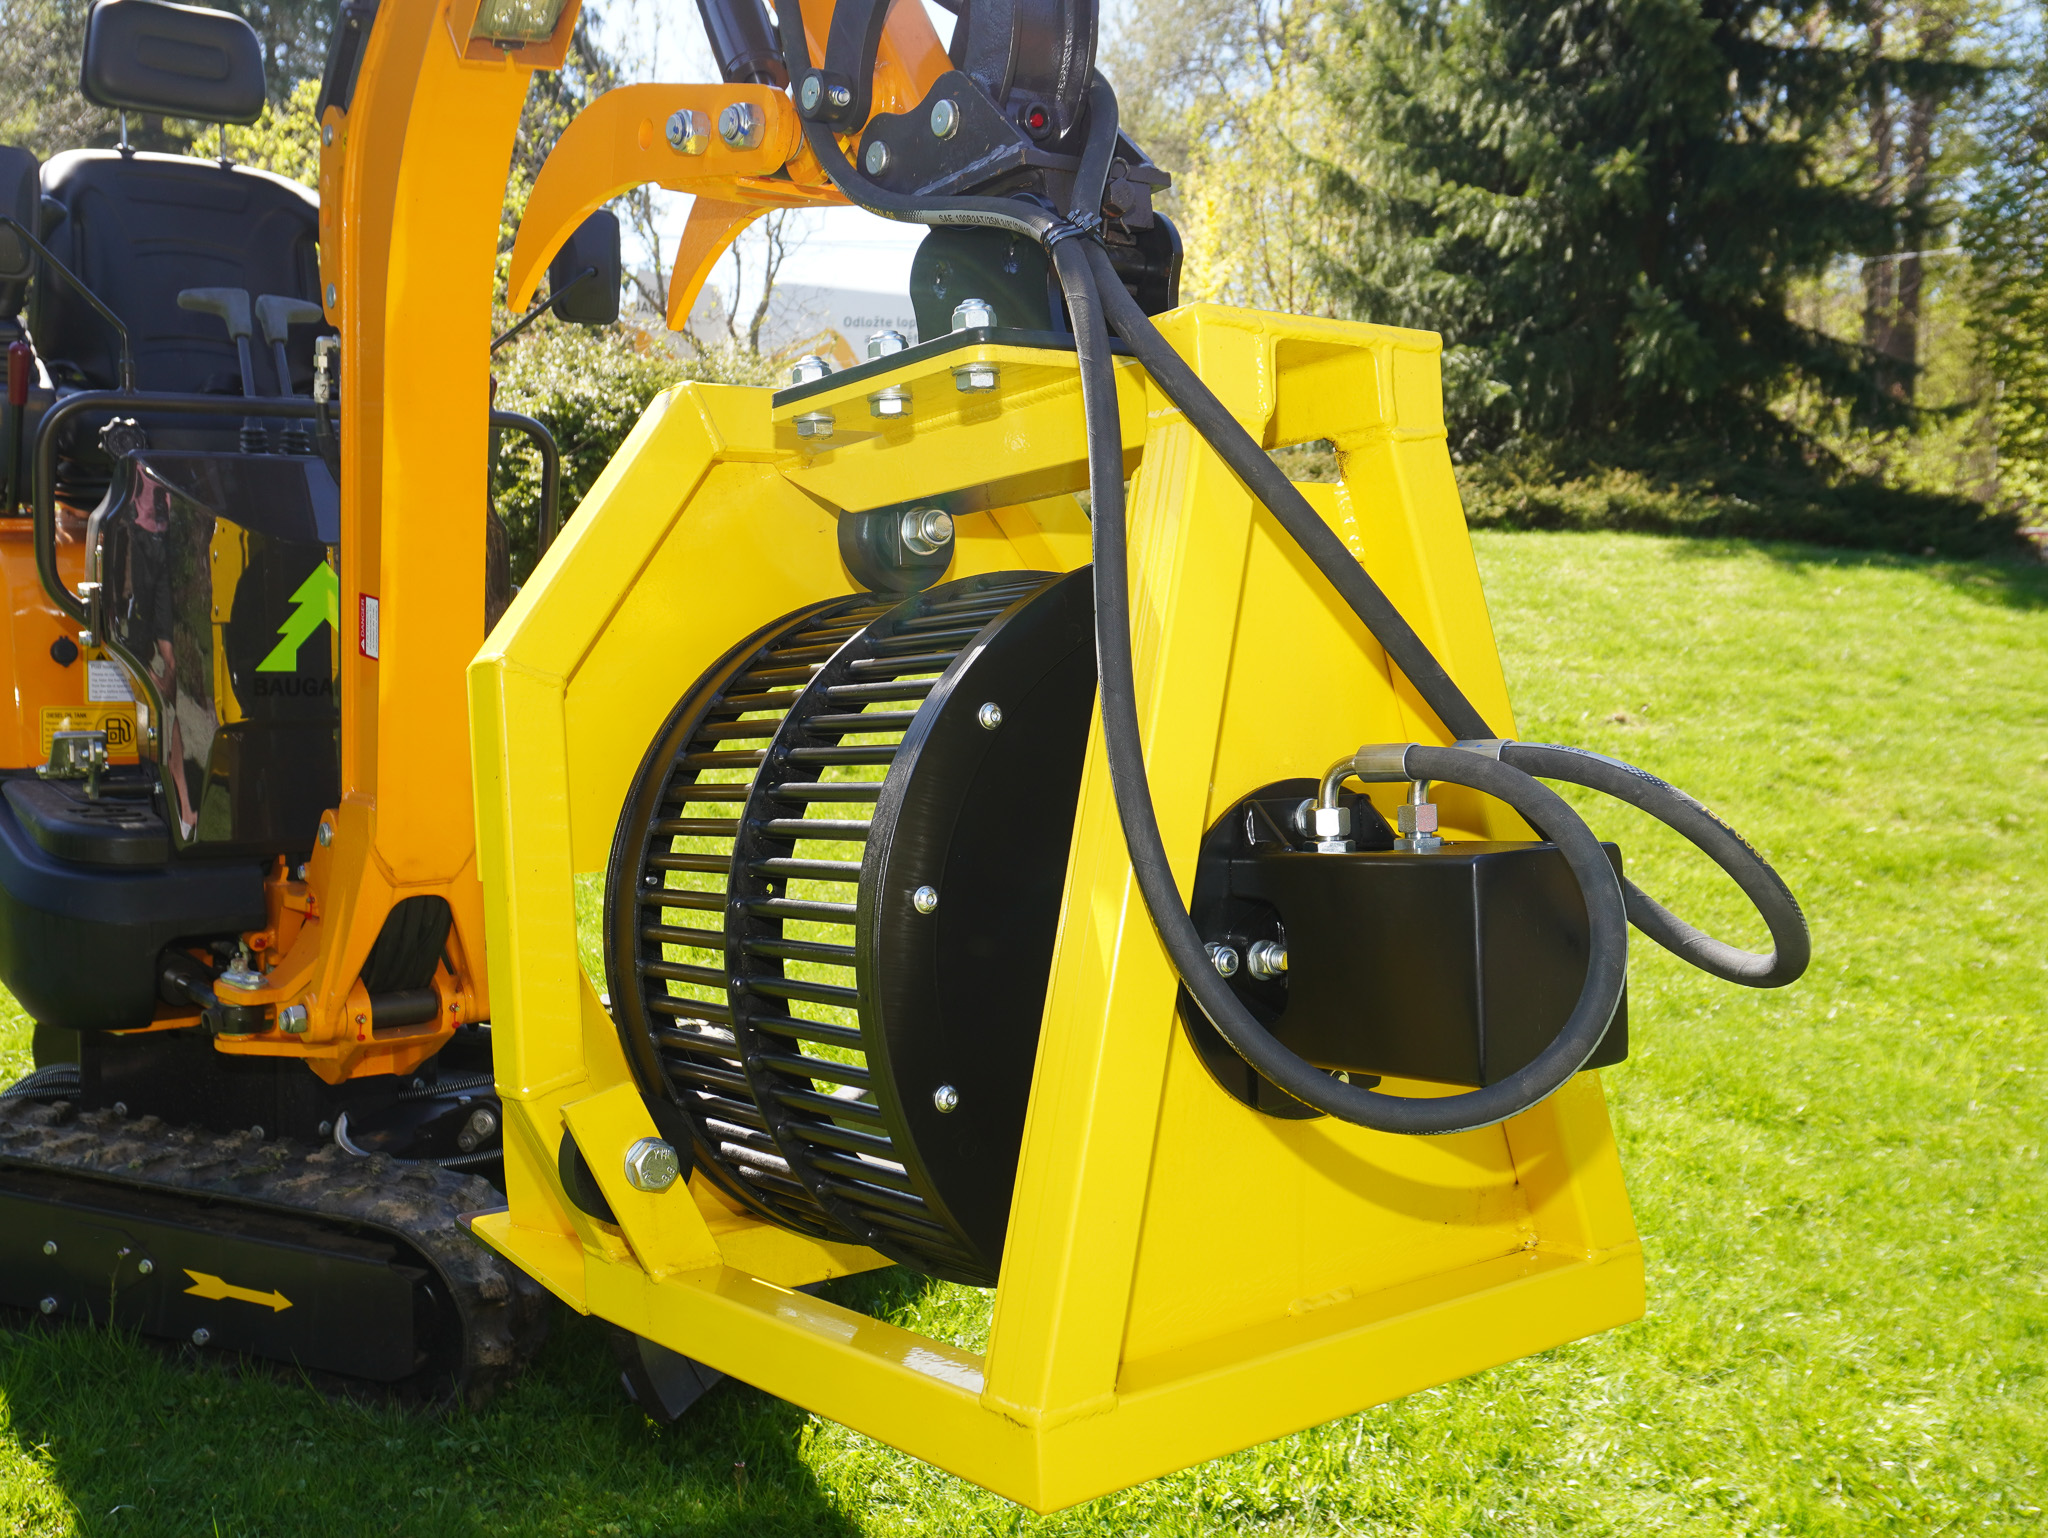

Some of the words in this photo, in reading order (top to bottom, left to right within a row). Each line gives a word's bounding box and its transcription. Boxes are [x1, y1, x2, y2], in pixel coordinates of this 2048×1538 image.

[938, 214, 954, 223] SAE
[843, 315, 893, 328] Odložte
[253, 677, 340, 697] BAUGA
